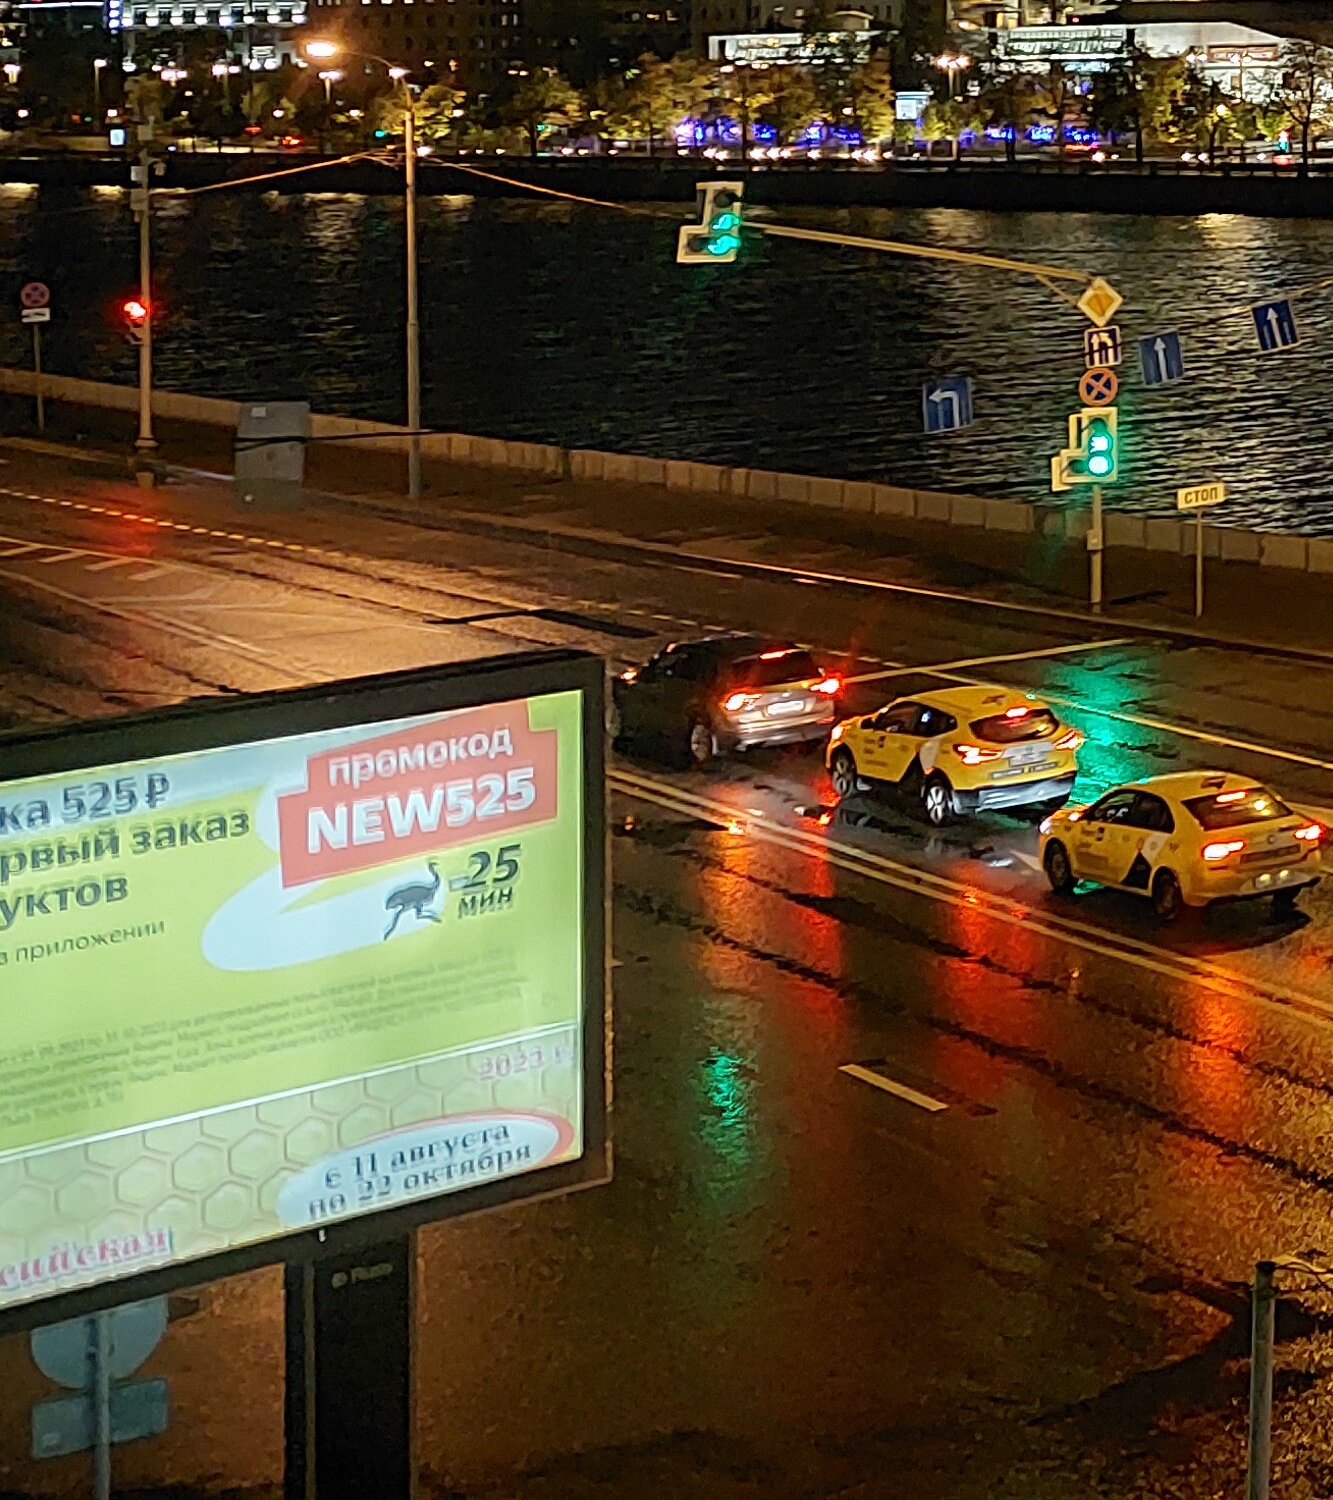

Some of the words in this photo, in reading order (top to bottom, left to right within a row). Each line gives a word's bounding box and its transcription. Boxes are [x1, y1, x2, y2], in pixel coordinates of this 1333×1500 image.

[1183, 486, 1219, 505] СТОП
[328, 728, 513, 789] промокод
[308, 766, 537, 855] NEW525
[0, 825, 121, 886] рвый
[131, 808, 250, 855] заказ
[0, 876, 129, 931] уктов
[15, 920, 166, 963] приложении
[391, 1124, 510, 1173] августа
[403, 1144, 532, 1191] октября
